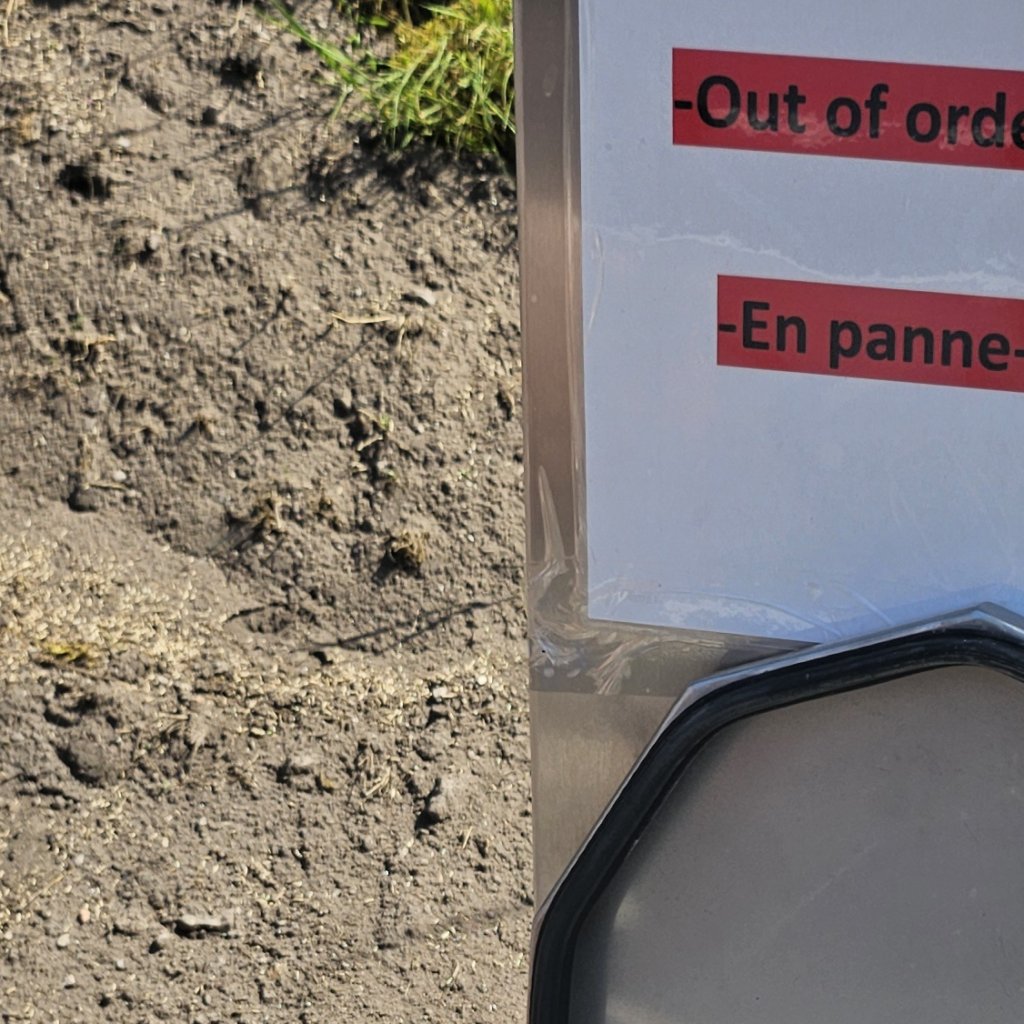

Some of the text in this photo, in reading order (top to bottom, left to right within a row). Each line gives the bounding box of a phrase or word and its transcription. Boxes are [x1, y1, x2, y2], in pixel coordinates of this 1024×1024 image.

[673, 75, 807, 134] -Out
[825, 83, 889, 139] of
[718, 300, 807, 354] -En
